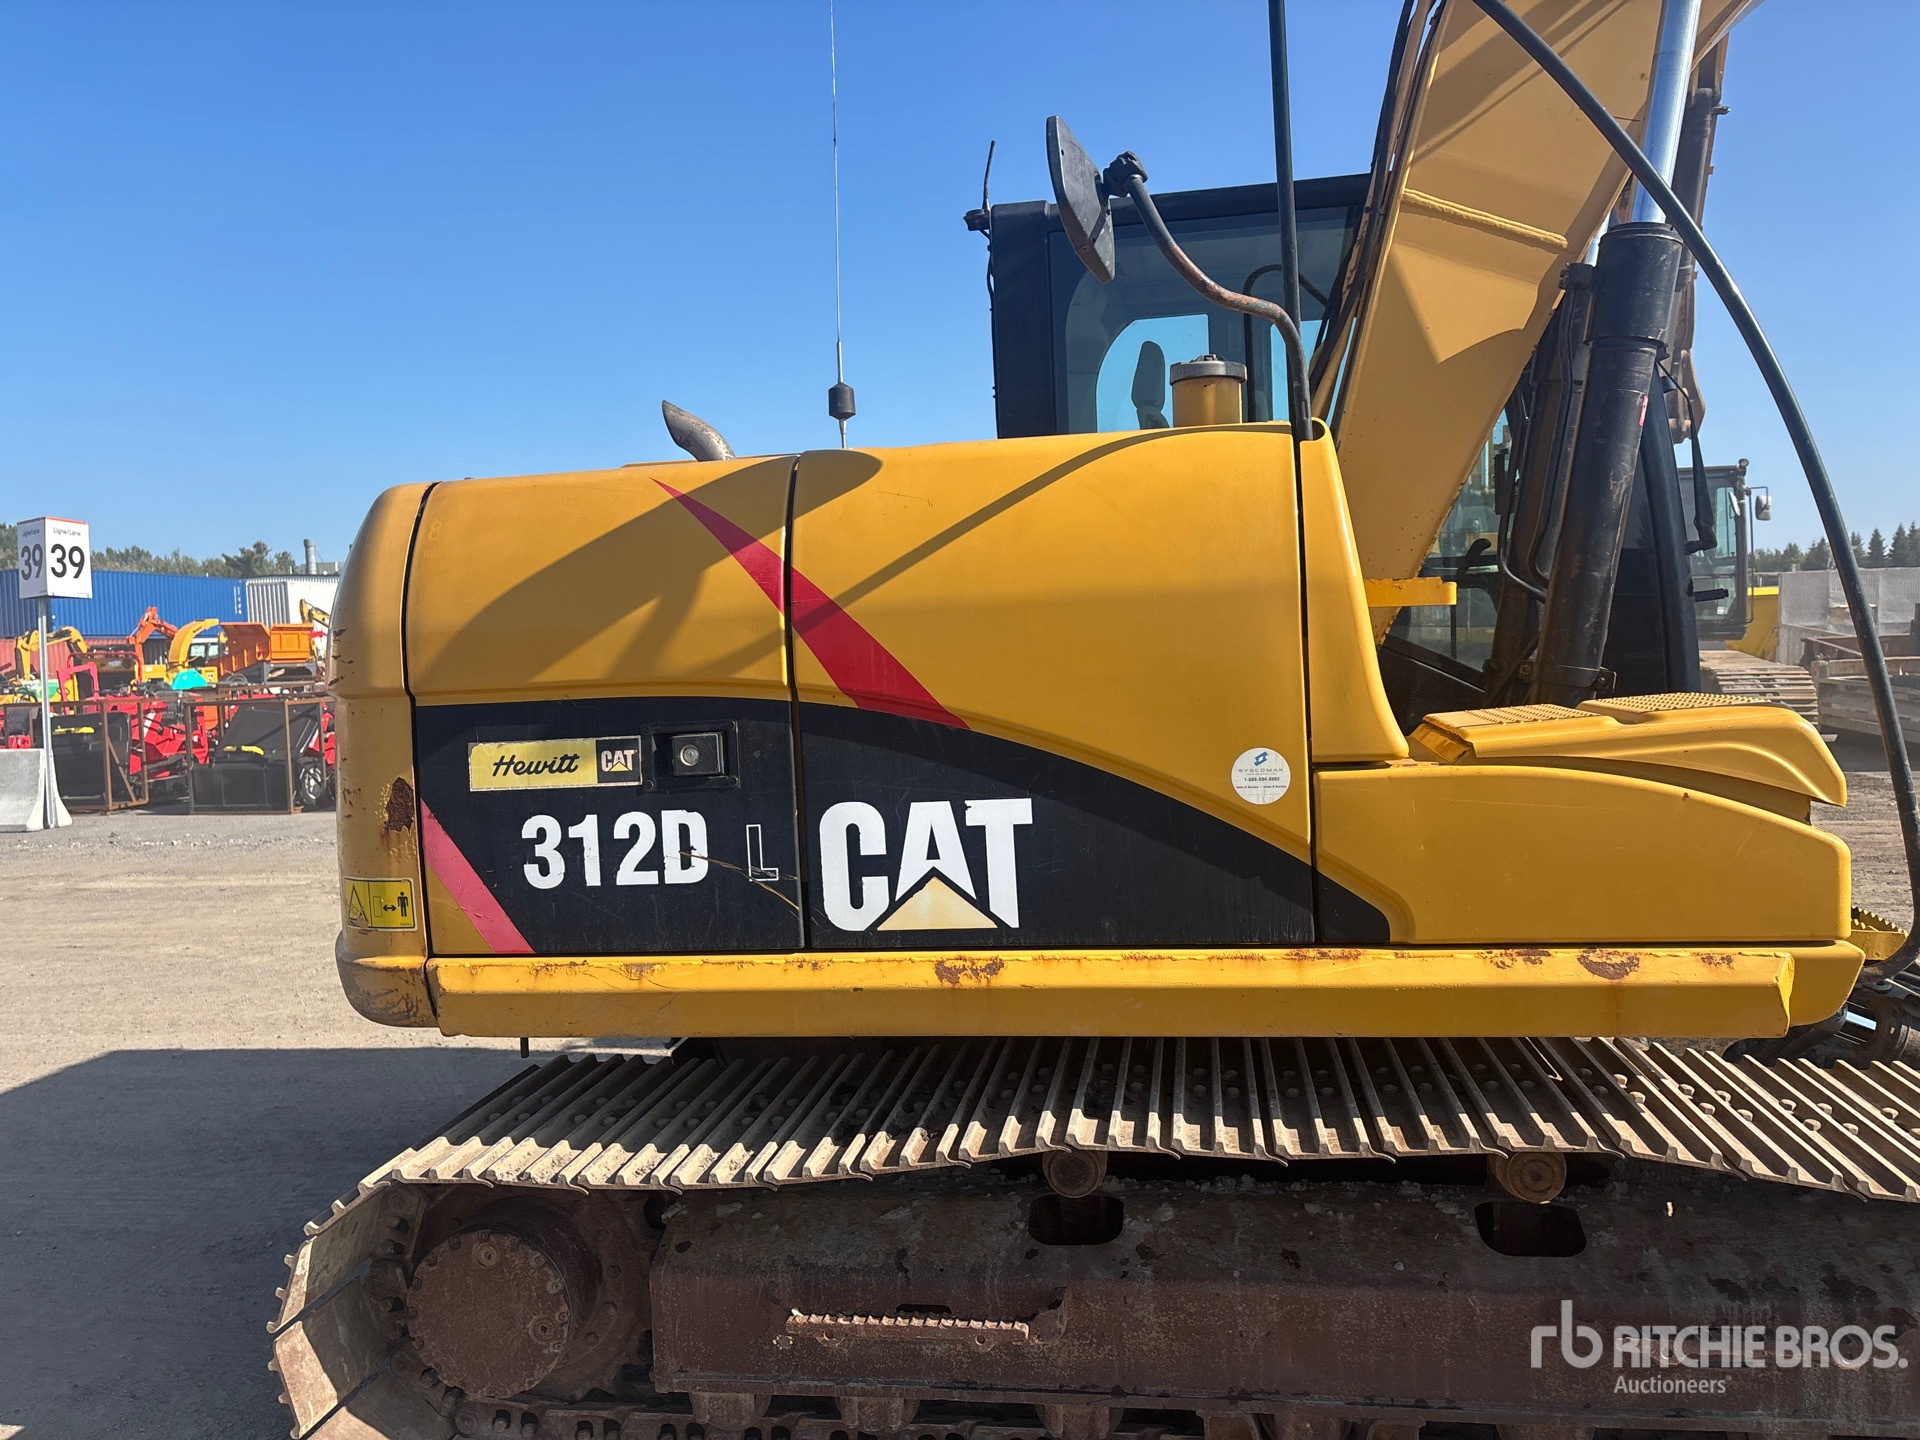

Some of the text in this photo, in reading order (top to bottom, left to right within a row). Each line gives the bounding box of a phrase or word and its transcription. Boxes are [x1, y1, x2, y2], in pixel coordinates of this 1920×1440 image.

[53, 527, 81, 537] Ligne/Lane
[20, 543, 44, 580] 39
[50, 543, 85, 579] 39
[492, 750, 635, 777] Hewitt CAT
[521, 810, 779, 889] 312D L
[819, 798, 1033, 931] CAT
